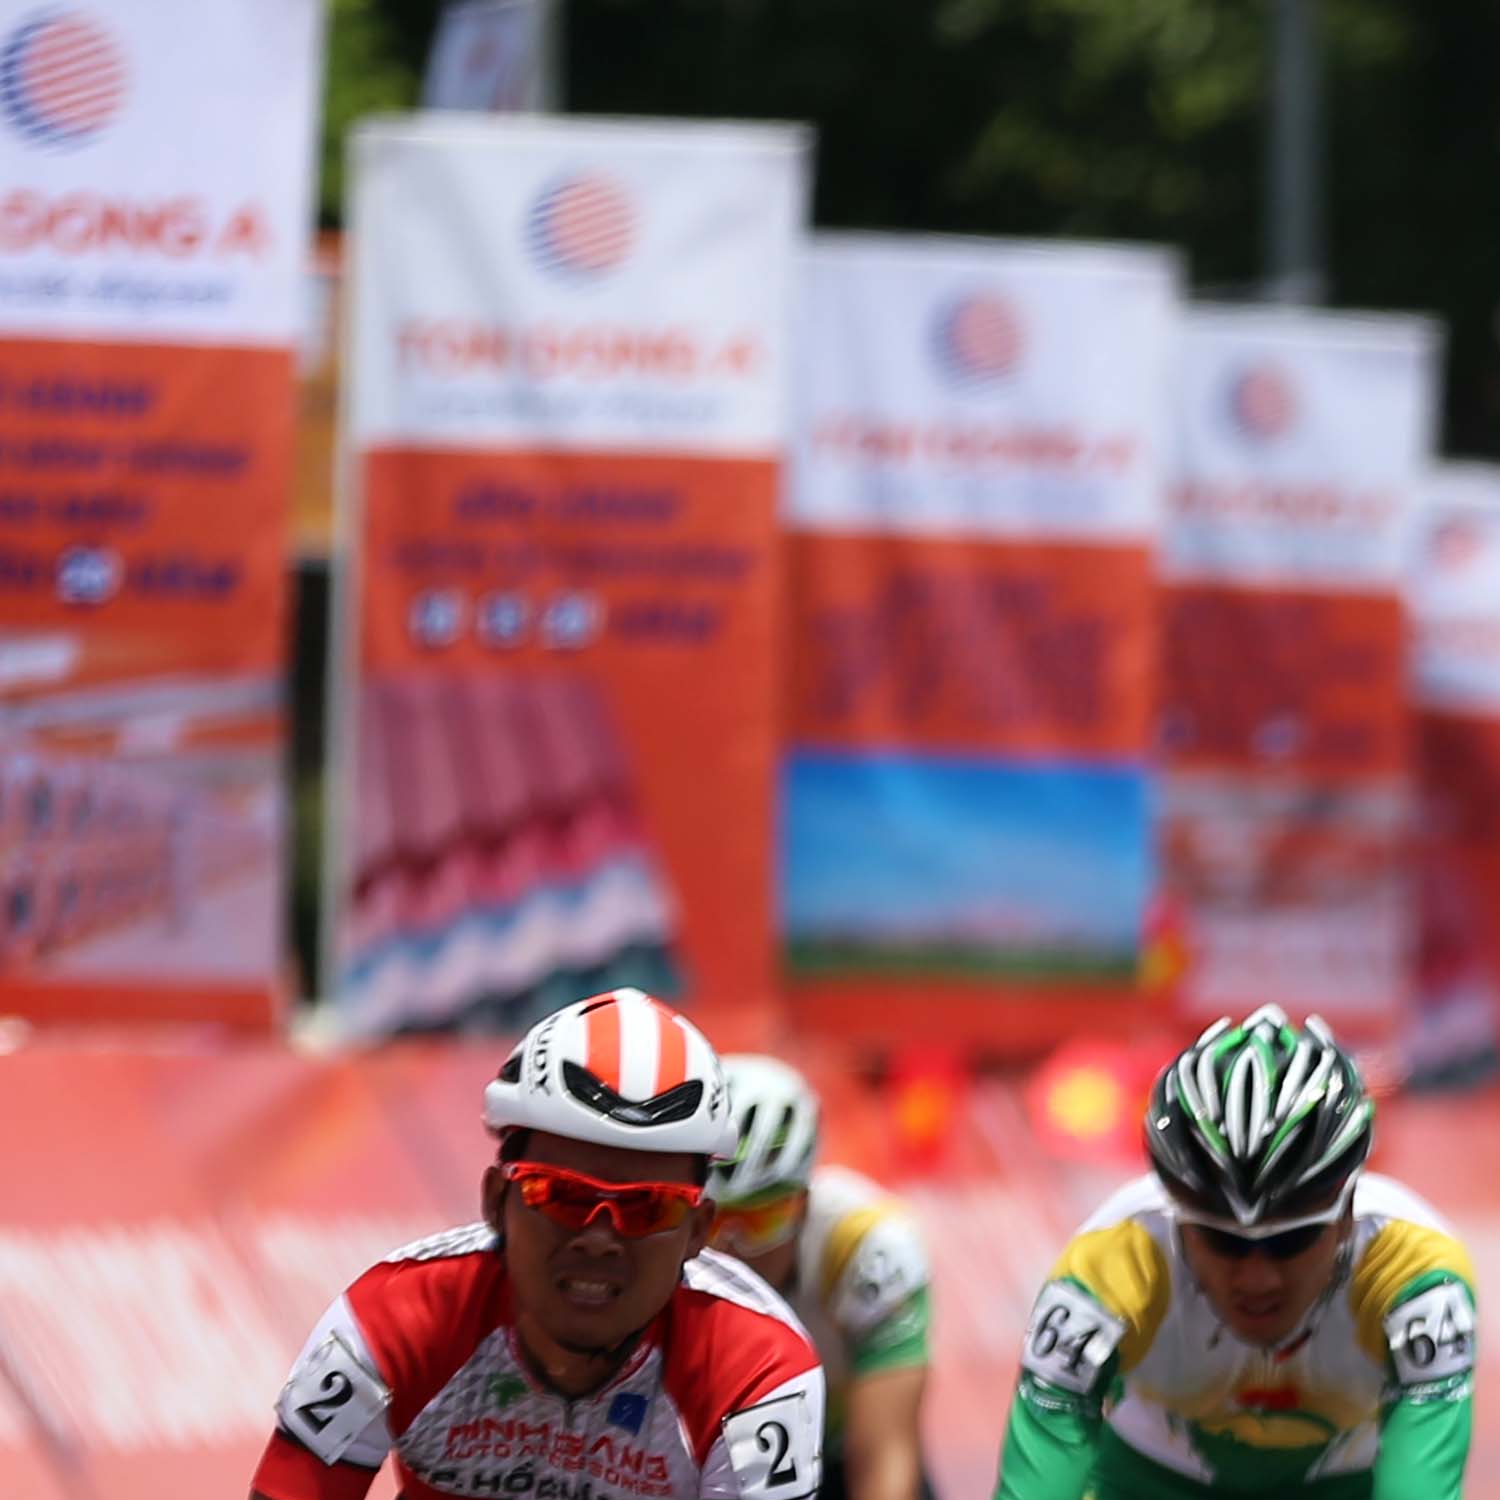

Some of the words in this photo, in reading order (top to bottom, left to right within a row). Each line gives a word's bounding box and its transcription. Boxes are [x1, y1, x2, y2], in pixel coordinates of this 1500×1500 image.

[1031, 1305, 1102, 1378] 64
[1401, 1300, 1469, 1369] 64
[294, 1370, 354, 1435] 2
[755, 1420, 798, 1490] 2
